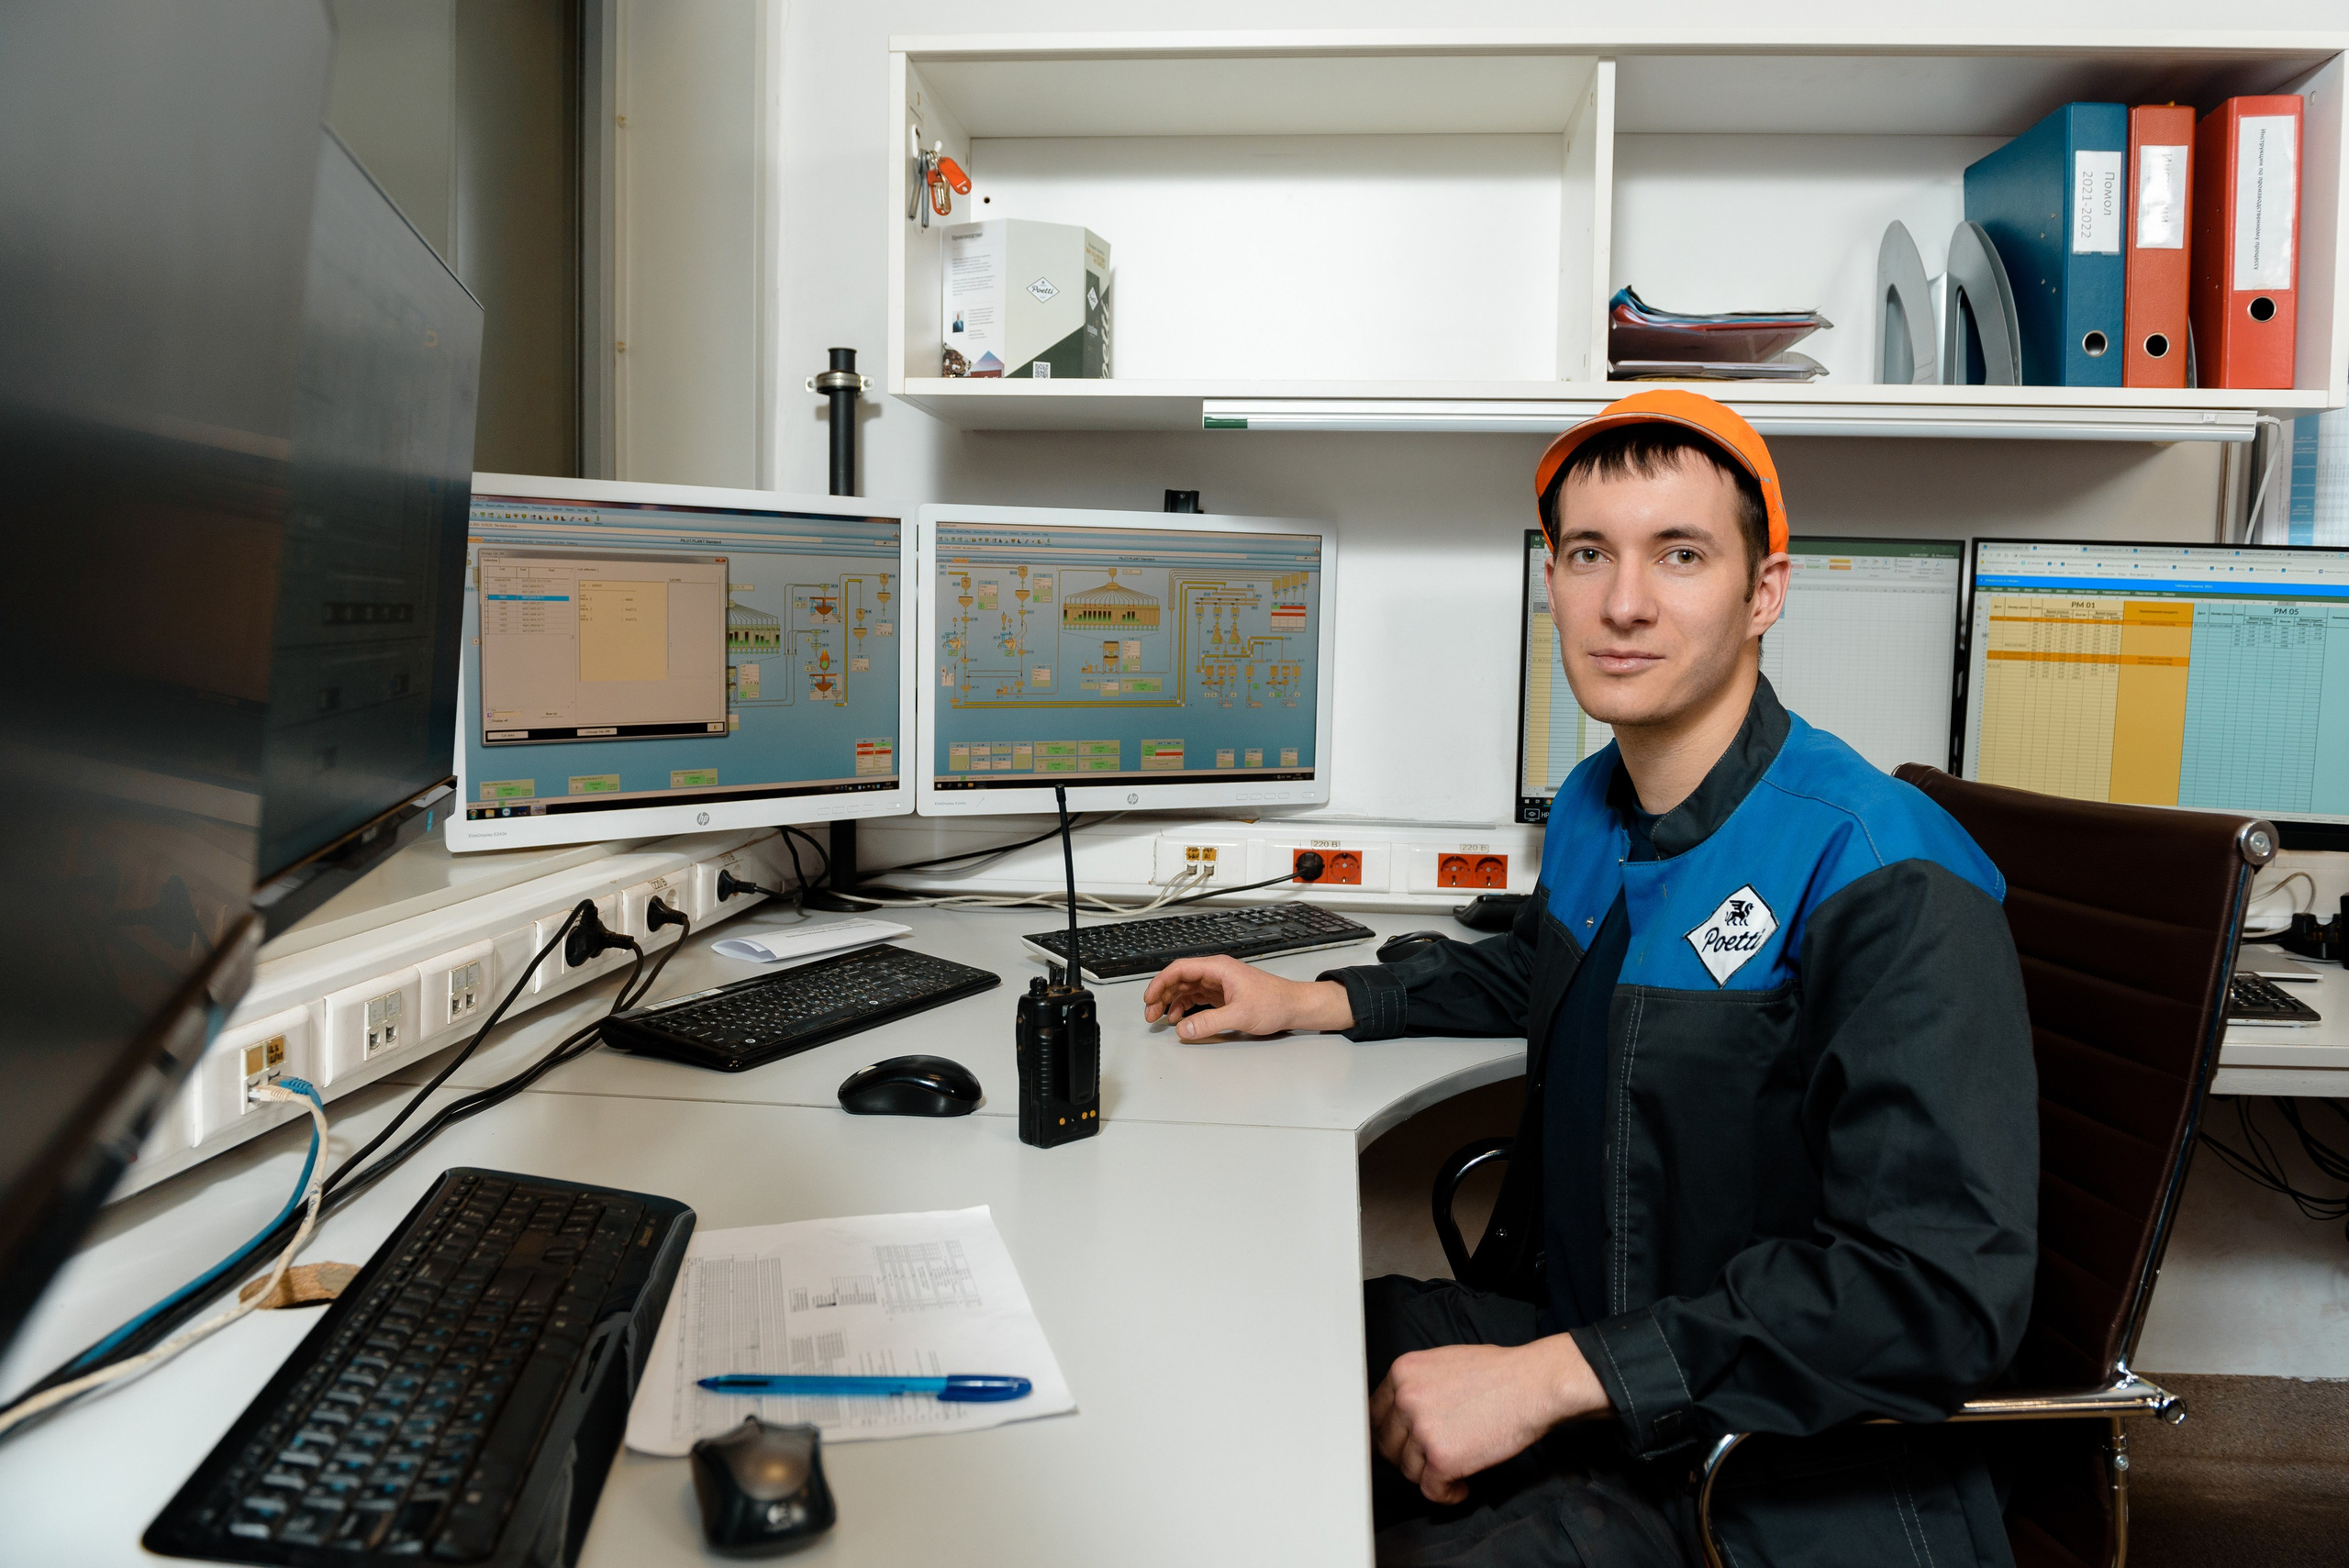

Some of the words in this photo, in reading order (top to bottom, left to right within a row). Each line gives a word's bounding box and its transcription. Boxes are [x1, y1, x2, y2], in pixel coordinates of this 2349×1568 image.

[2258, 128, 2266, 166] Инструкции
[2258, 167, 2264, 175] по
[2103, 172, 2115, 216] Помол
[2081, 172, 2093, 239] 2021-2022
[2254, 176, 2263, 240] производственному
[1031, 285, 1054, 295] Poetti
[1127, 793, 1139, 805] hp
[696, 811, 710, 826] hp
[651, 879, 662, 889] 220
[1701, 927, 1766, 952] Poetti
